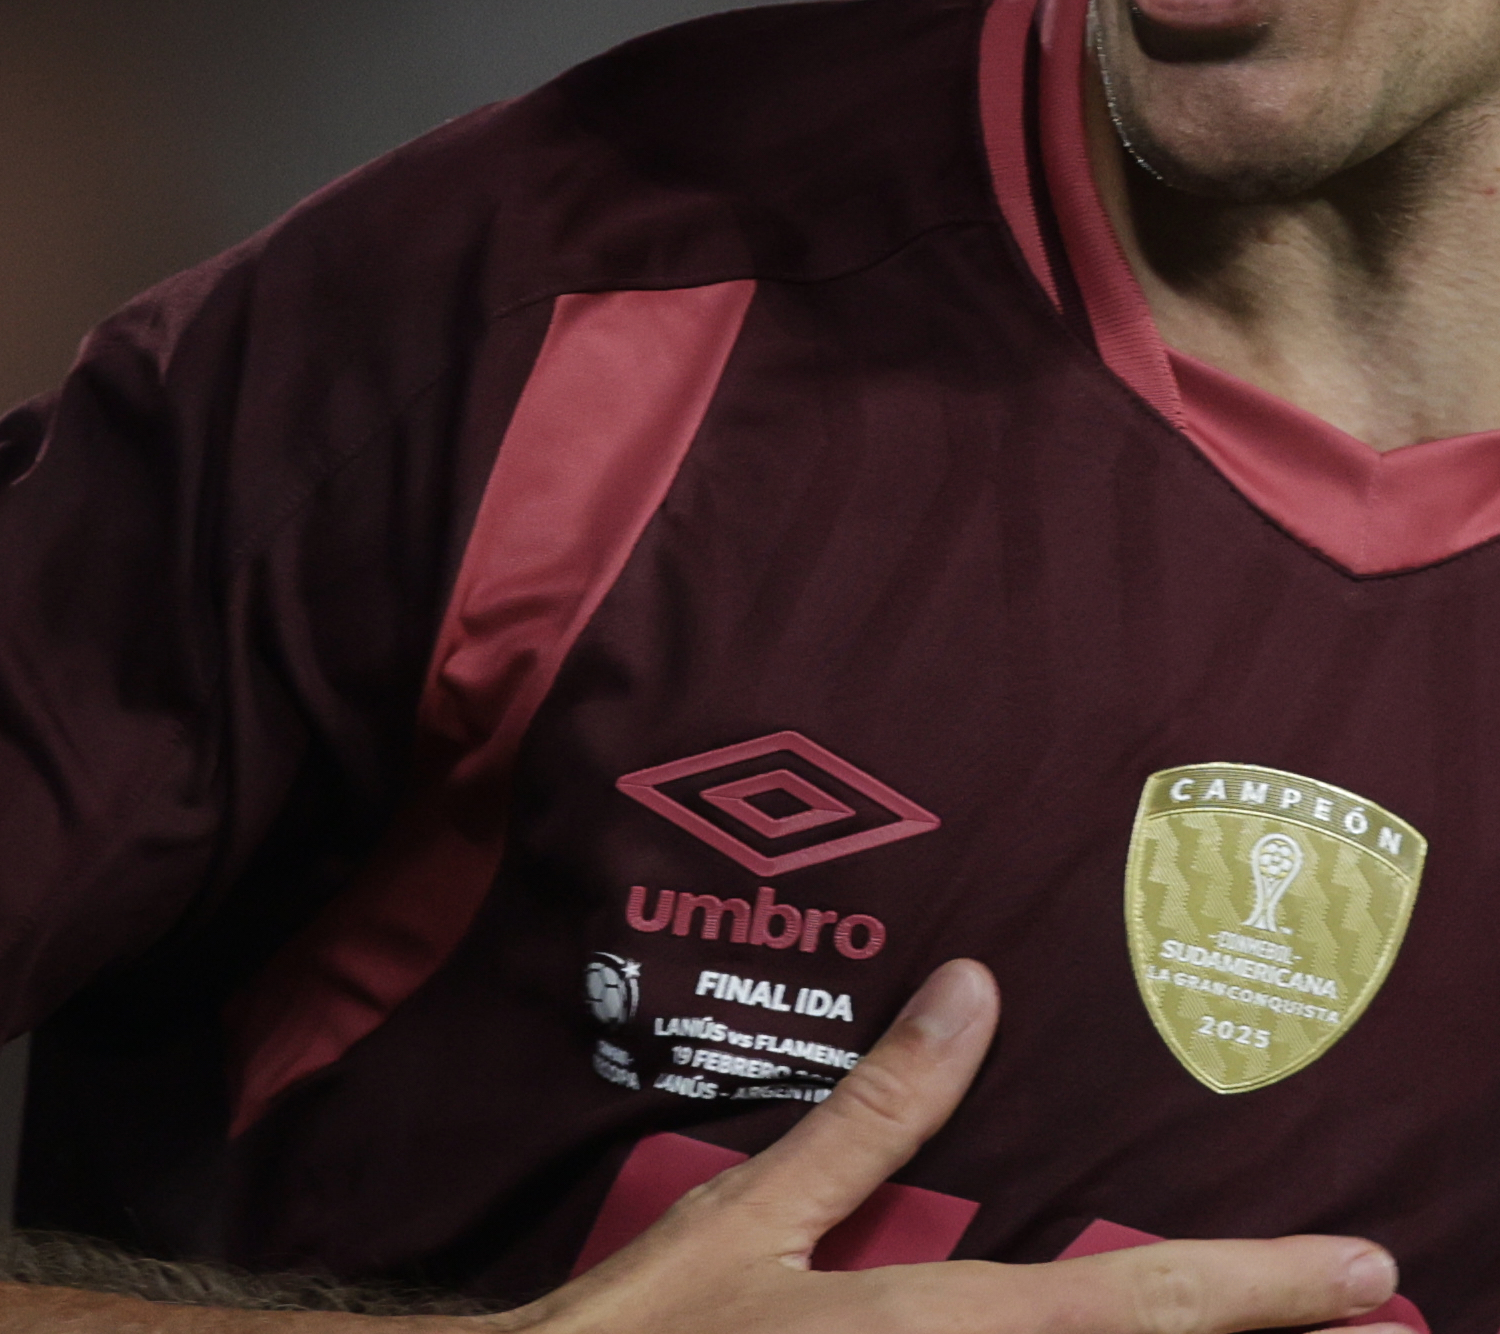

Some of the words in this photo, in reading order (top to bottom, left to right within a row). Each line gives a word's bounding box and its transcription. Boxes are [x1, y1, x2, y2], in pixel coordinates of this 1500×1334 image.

[1169, 777, 1403, 856] CAMPEÓN
[625, 885, 887, 960] umbro
[695, 970, 791, 1013] FINAL
[794, 986, 854, 1022] IDA
[1159, 938, 1339, 1000] SUDAMERICANA
[654, 1016, 728, 1043] LANÚS
[726, 1030, 754, 1049] vs
[753, 1033, 862, 1071] FLAMENG
[1196, 1015, 1272, 1050] 2025
[671, 1044, 694, 1066] 19
[691, 1048, 792, 1080] FEBRERO
